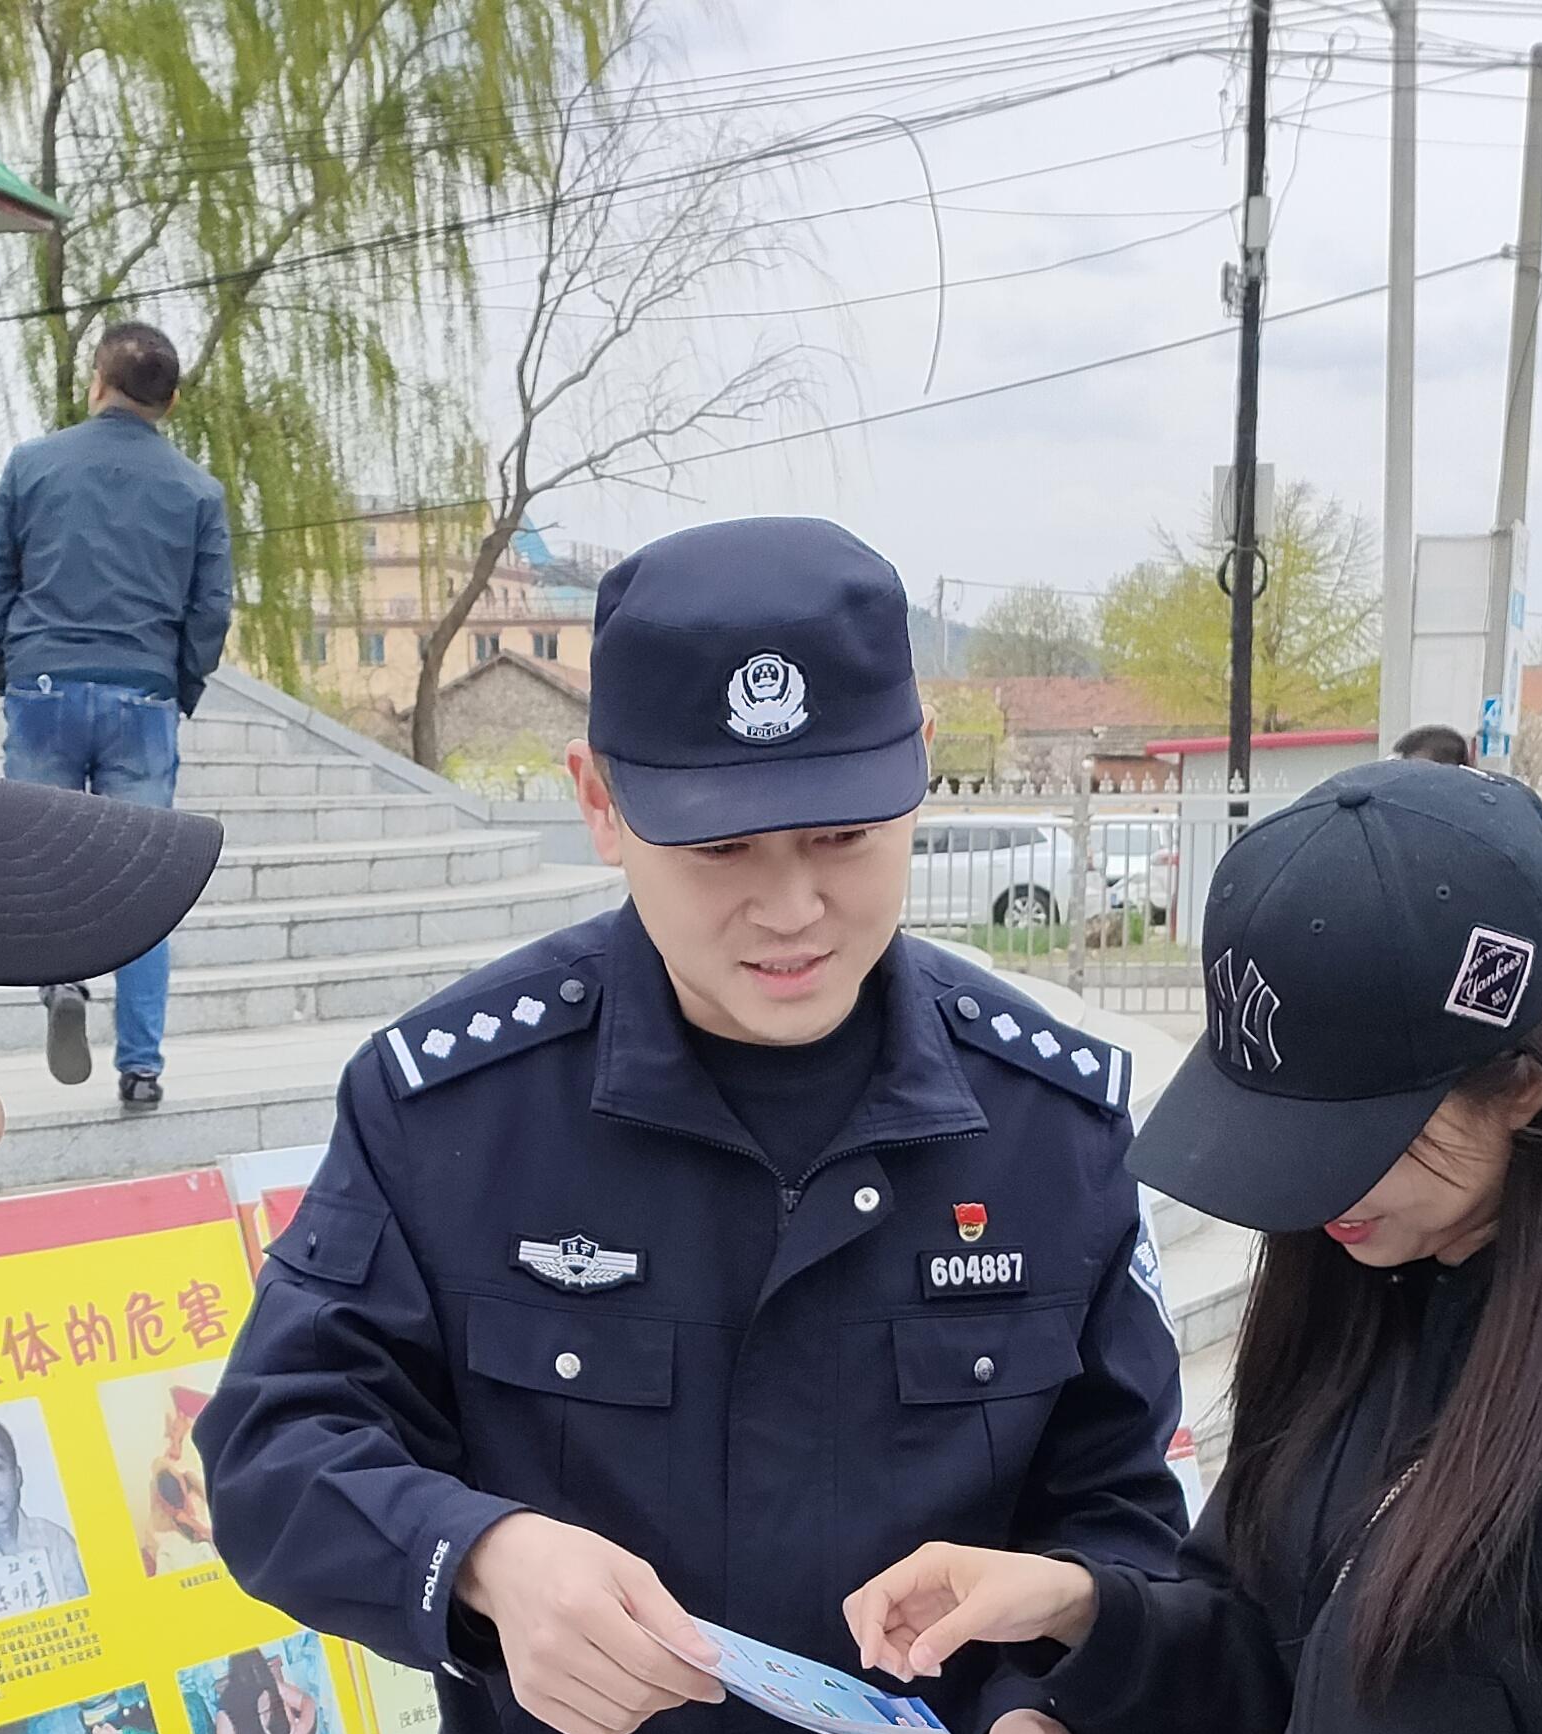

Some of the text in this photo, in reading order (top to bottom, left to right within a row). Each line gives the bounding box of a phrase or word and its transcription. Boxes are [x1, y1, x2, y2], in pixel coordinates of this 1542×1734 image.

[749, 721, 788, 737] POLICE
[1461, 953, 1522, 1007] Yankees
[567, 1241, 592, 1255] 辽宁
[930, 1253, 1024, 1287] 604887
[422, 1539, 450, 1612] POLICE
